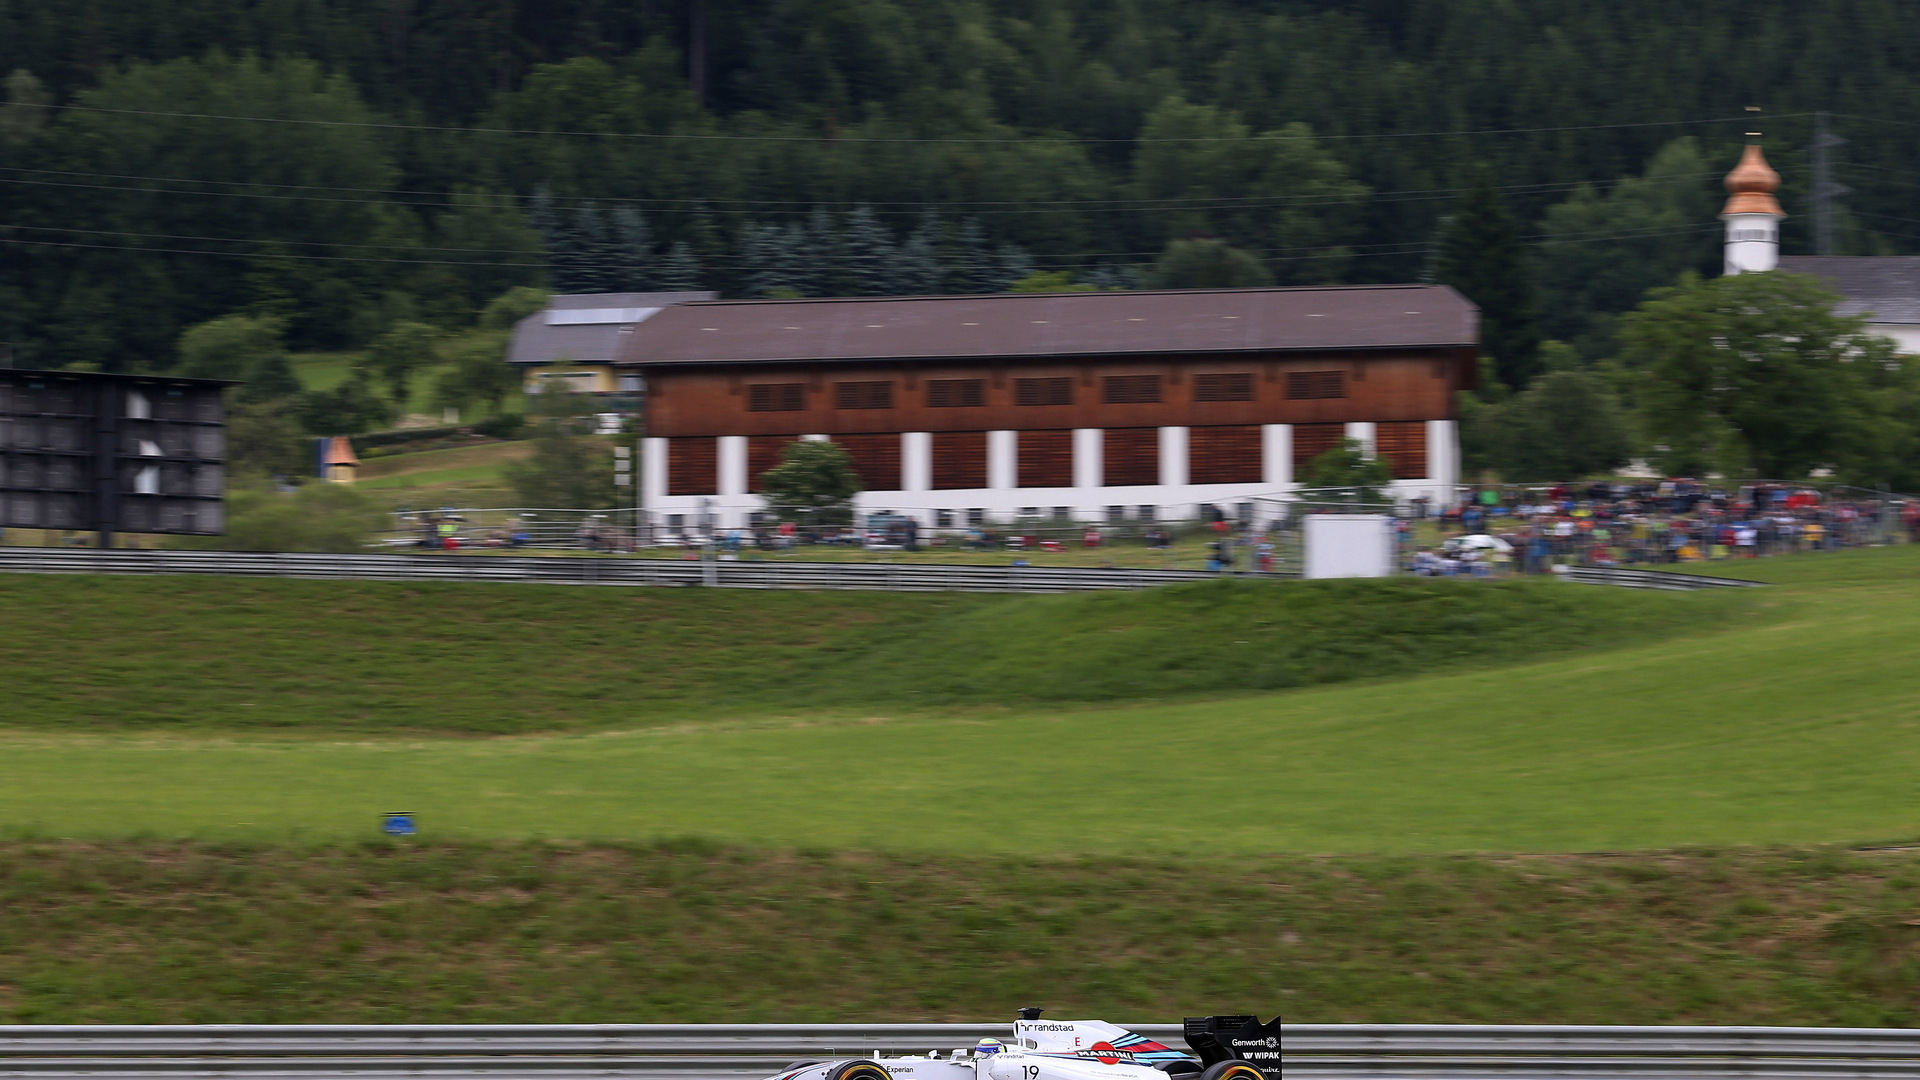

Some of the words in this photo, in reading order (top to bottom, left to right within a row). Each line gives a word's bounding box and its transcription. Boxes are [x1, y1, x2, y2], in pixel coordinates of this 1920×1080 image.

[1034, 1023, 1074, 1032] randstad
[1231, 1038, 1265, 1047] Genworth
[1077, 1050, 1133, 1060] MARTINI
[1254, 1052, 1280, 1060] WIPAK
[886, 1065, 914, 1074] Experian
[1021, 1065, 1040, 1080] 19
